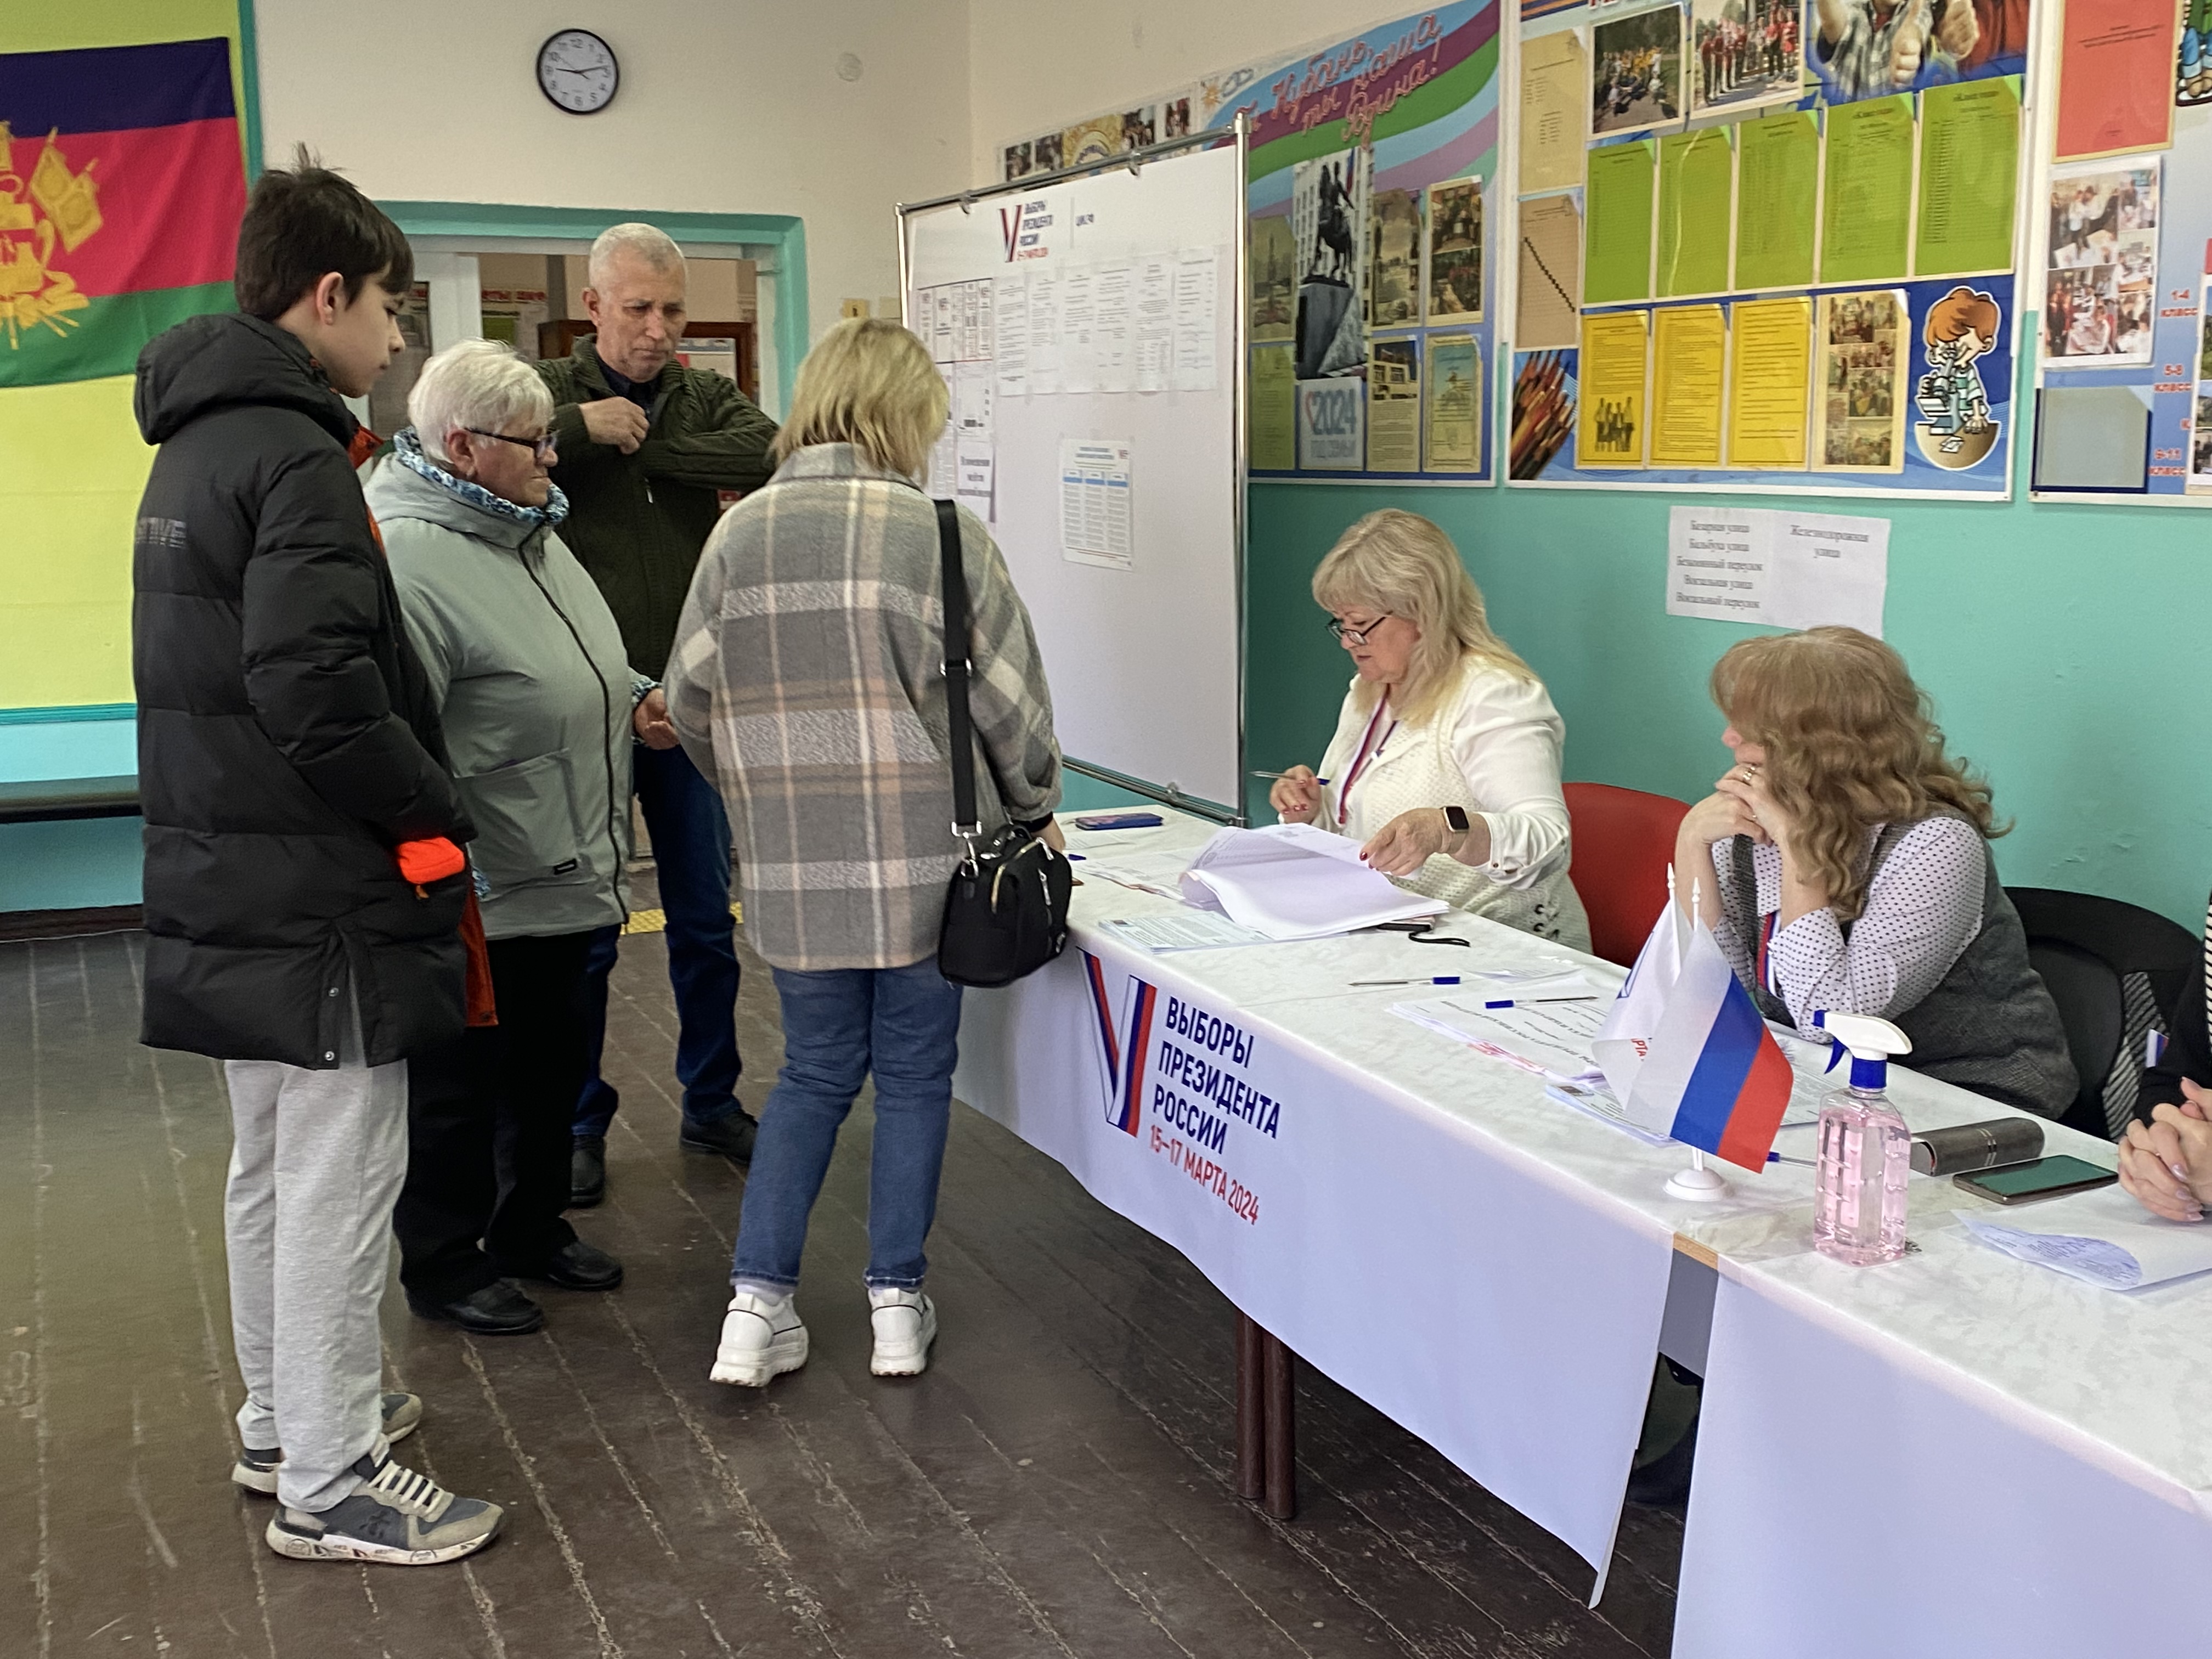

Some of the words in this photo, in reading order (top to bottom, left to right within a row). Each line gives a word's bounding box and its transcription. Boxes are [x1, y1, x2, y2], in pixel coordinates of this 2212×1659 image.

[1165, 995, 1255, 1069] ВЫБОРЫ
[1630, 1038, 1648, 1057] РТА
[1153, 1083, 1228, 1155] РОССИИ
[1158, 1040, 1280, 1139] ПРЕЗИДЕНТА
[1183, 1147, 1228, 1201] МАРТА
[1228, 1179, 1259, 1226] 2024
